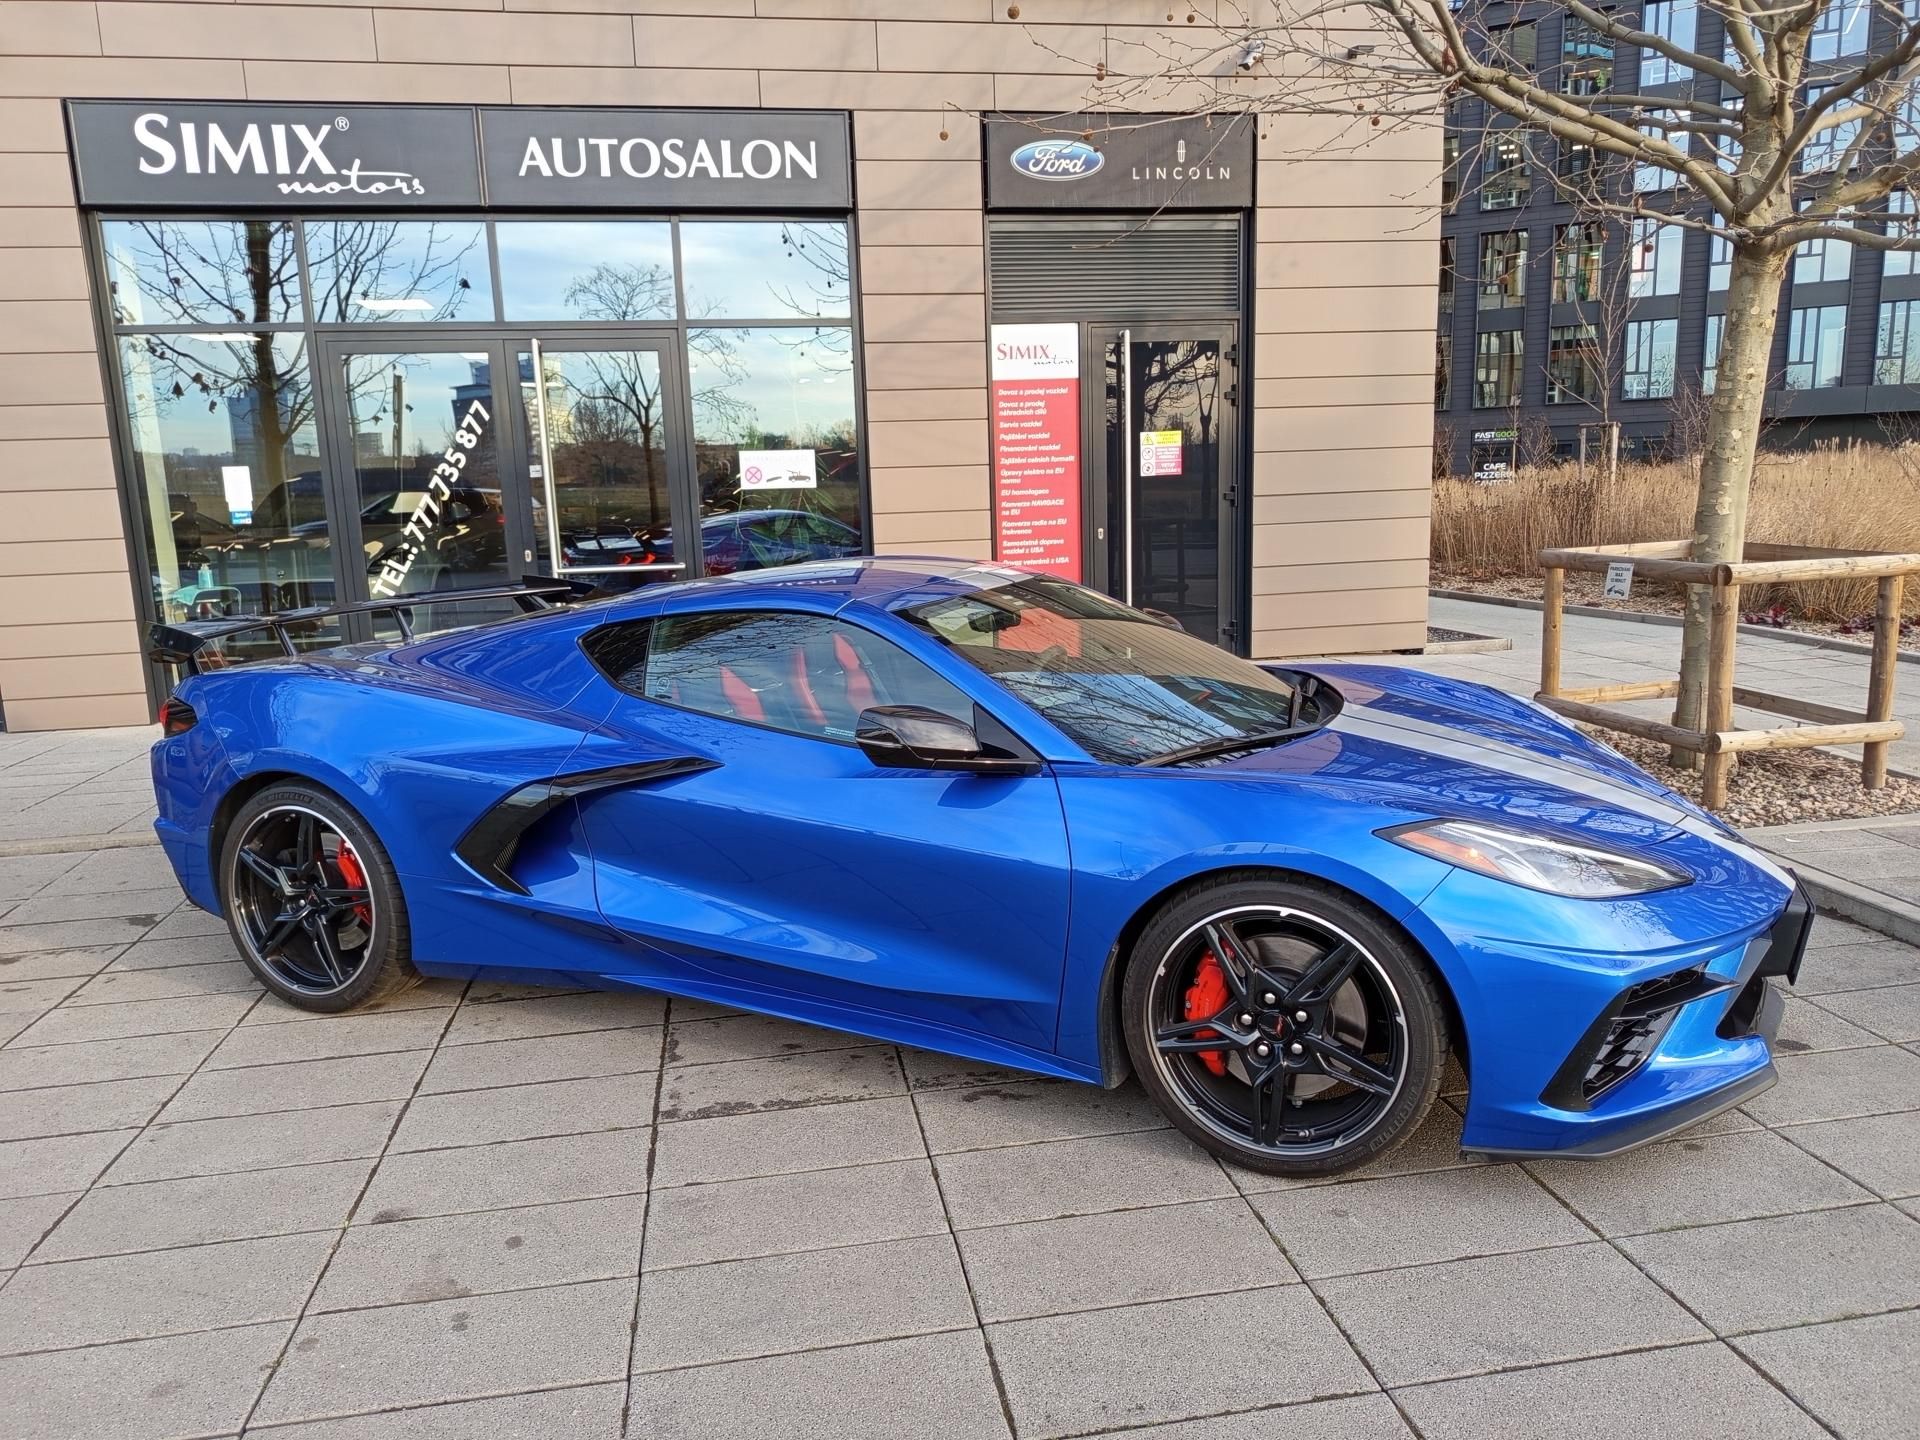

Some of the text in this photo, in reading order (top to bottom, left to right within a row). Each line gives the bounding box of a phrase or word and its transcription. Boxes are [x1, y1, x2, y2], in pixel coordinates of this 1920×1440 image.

[518, 136, 817, 179] AUTOSALON
[1028, 146, 1086, 174] Ford
[277, 158, 425, 194] motors
[1132, 167, 1231, 180] LINCOLN
[996, 342, 1051, 361] SIMIX
[998, 388, 1019, 396] Dovoz
[1024, 387, 1045, 397] prodej
[1046, 386, 1069, 395] vozidel
[1024, 399, 1046, 409] prodej
[999, 419, 1043, 429] Servis vozidel
[1028, 431, 1050, 440] vozidel
[1038, 443, 1061, 452] vozidel
[402, 493, 440, 543] 777
[428, 447, 467, 502] 735
[455, 399, 490, 450] 877
[1054, 466, 1065, 475] EU
[1011, 487, 1050, 497] homologace
[1001, 498, 1065, 508] Konverze NAVIGACE
[1010, 508, 1021, 516] EU
[1001, 519, 1031, 529] Konverze
[1056, 517, 1068, 526] EU
[1002, 547, 1025, 555] vozidel
[1030, 545, 1044, 554] USA
[1055, 555, 1070, 564] USA
